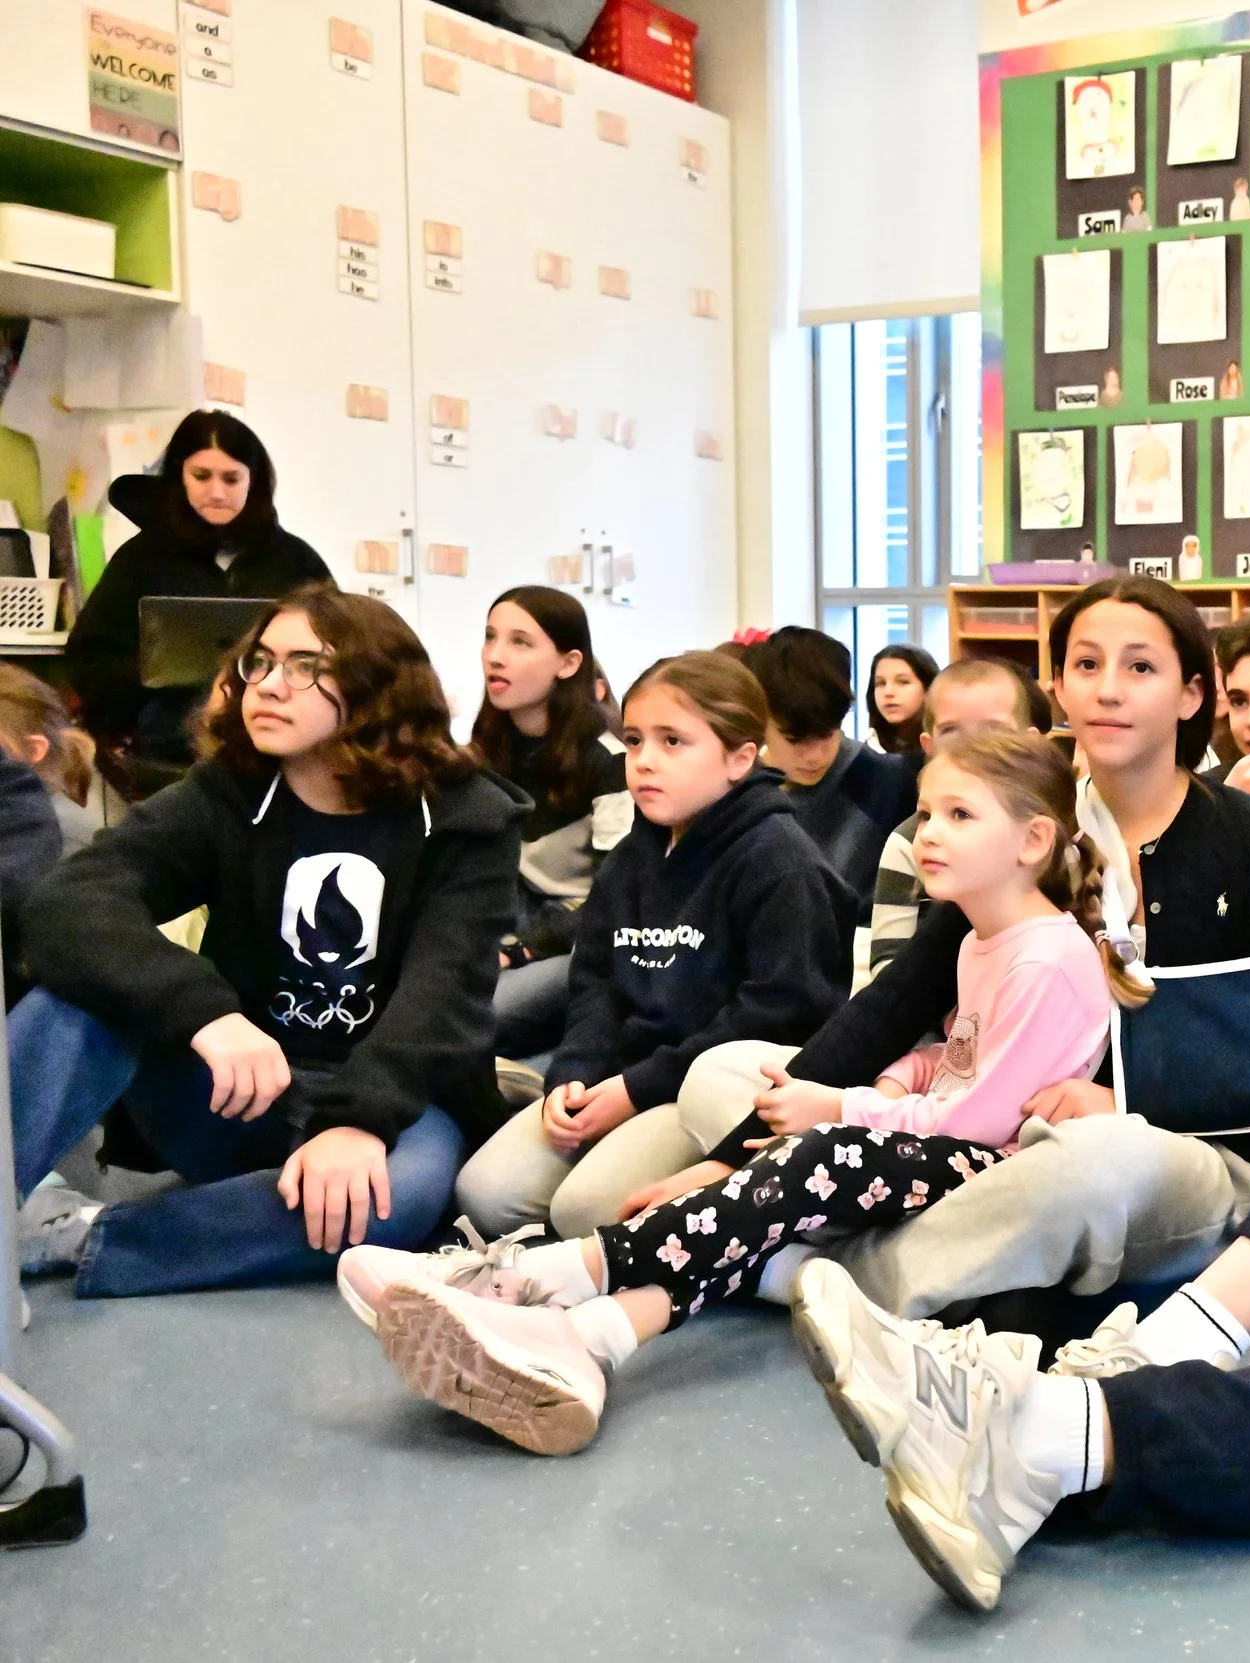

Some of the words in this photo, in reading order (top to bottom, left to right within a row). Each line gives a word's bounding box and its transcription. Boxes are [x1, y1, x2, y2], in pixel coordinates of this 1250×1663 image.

[196, 22, 219, 37] and
[90, 52, 176, 91] WELCOME
[1084, 216, 1116, 235] Sam
[1175, 381, 1208, 400] Rose
